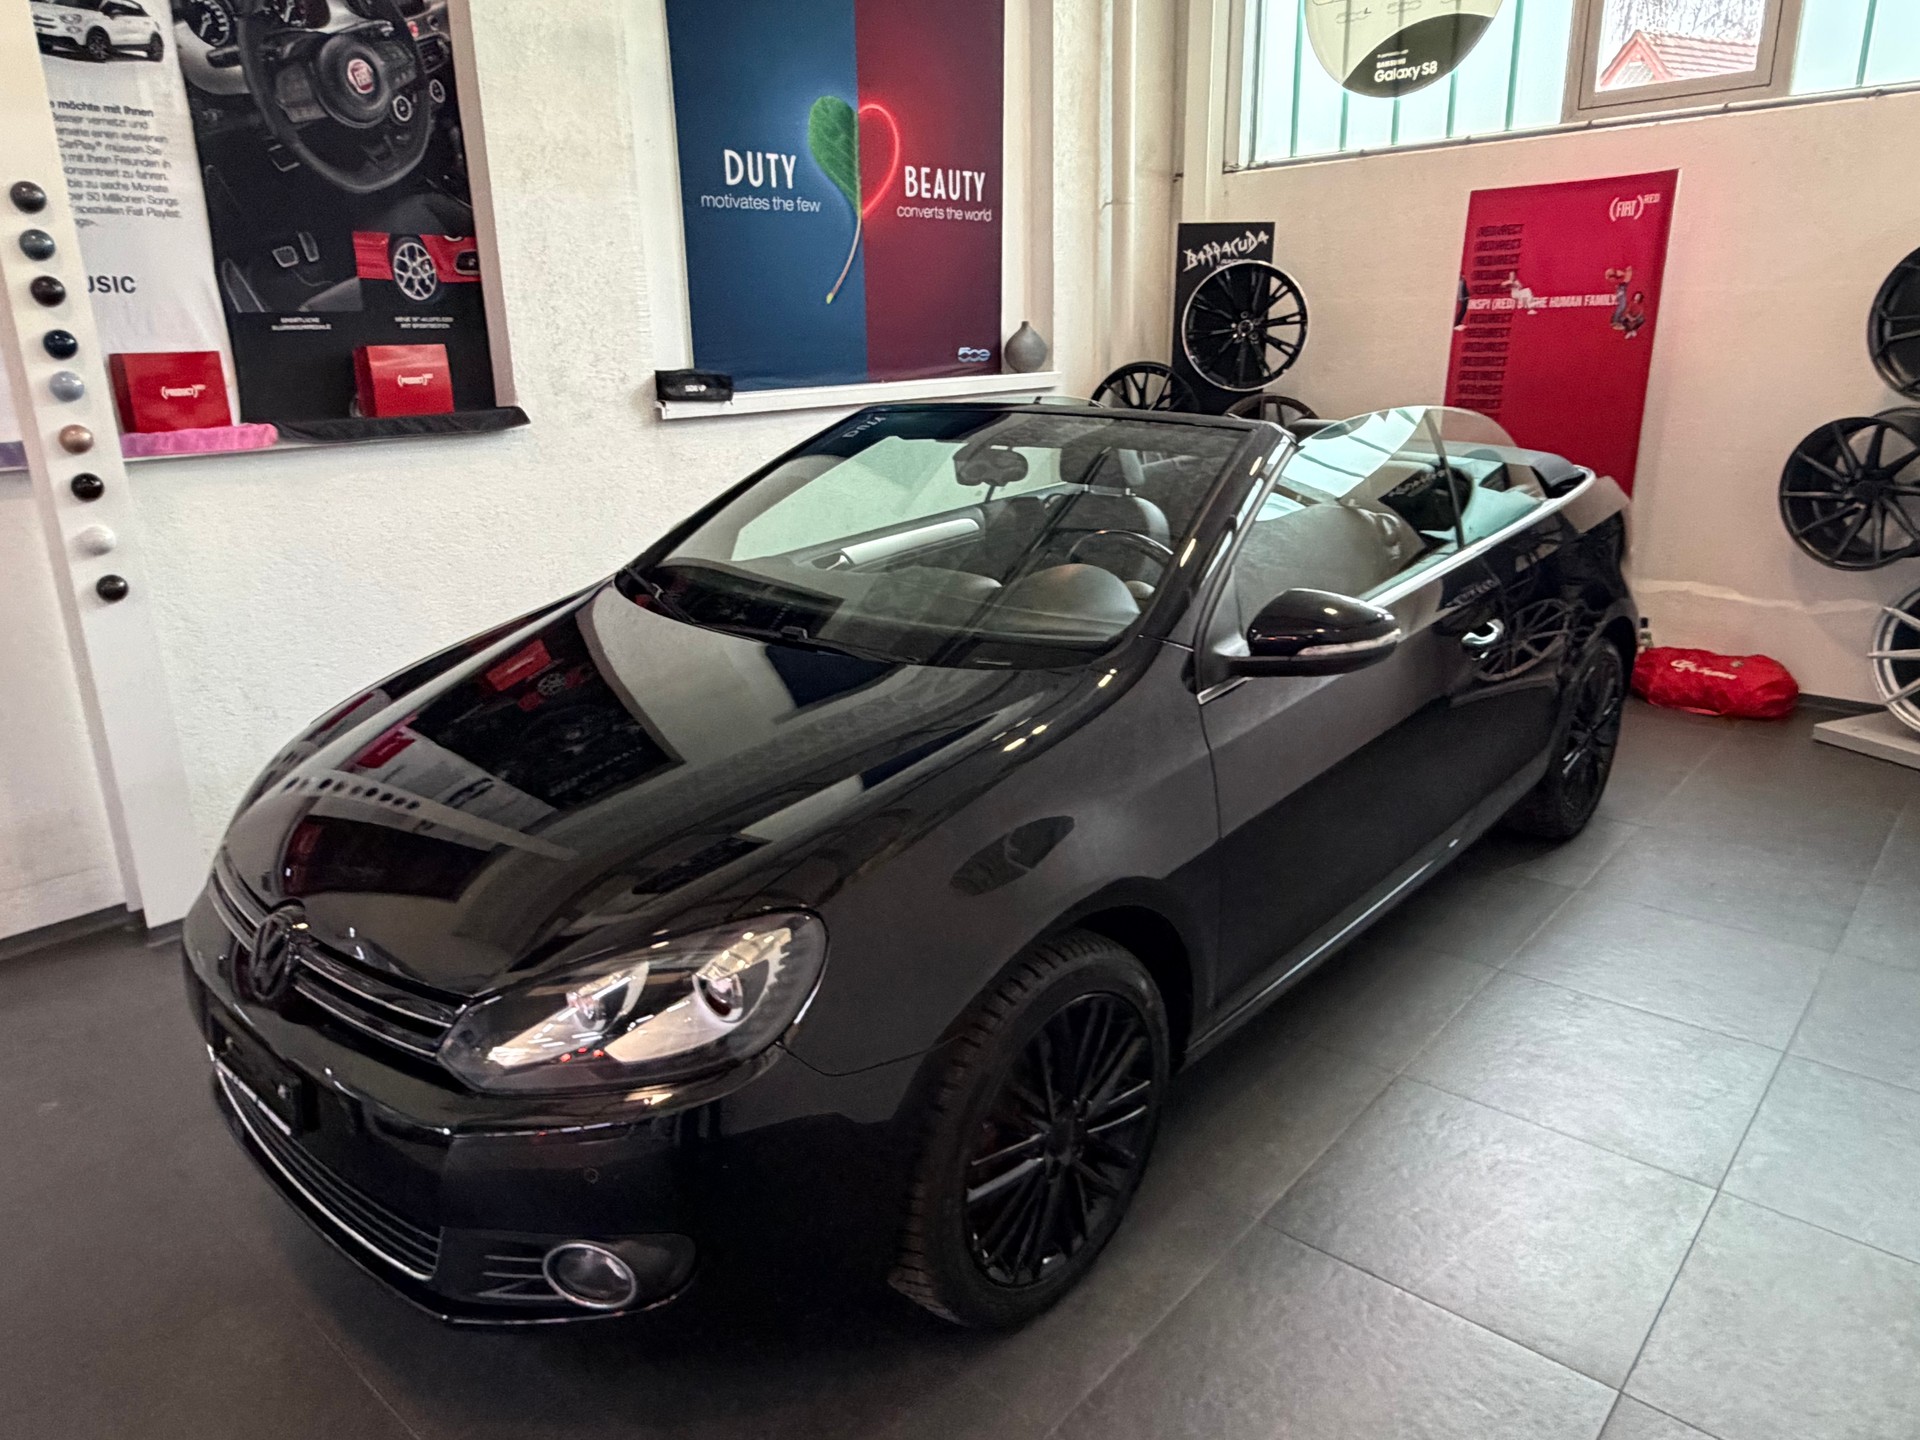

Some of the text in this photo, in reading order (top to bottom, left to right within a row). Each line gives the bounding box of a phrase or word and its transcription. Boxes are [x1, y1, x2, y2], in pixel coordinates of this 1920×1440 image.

[1374, 60, 1438, 82] Galaxy S8
[724, 149, 796, 189] DUTY
[904, 165, 986, 202] BEAUTY
[700, 193, 821, 212] motivates the few
[896, 205, 993, 222] converts the world
